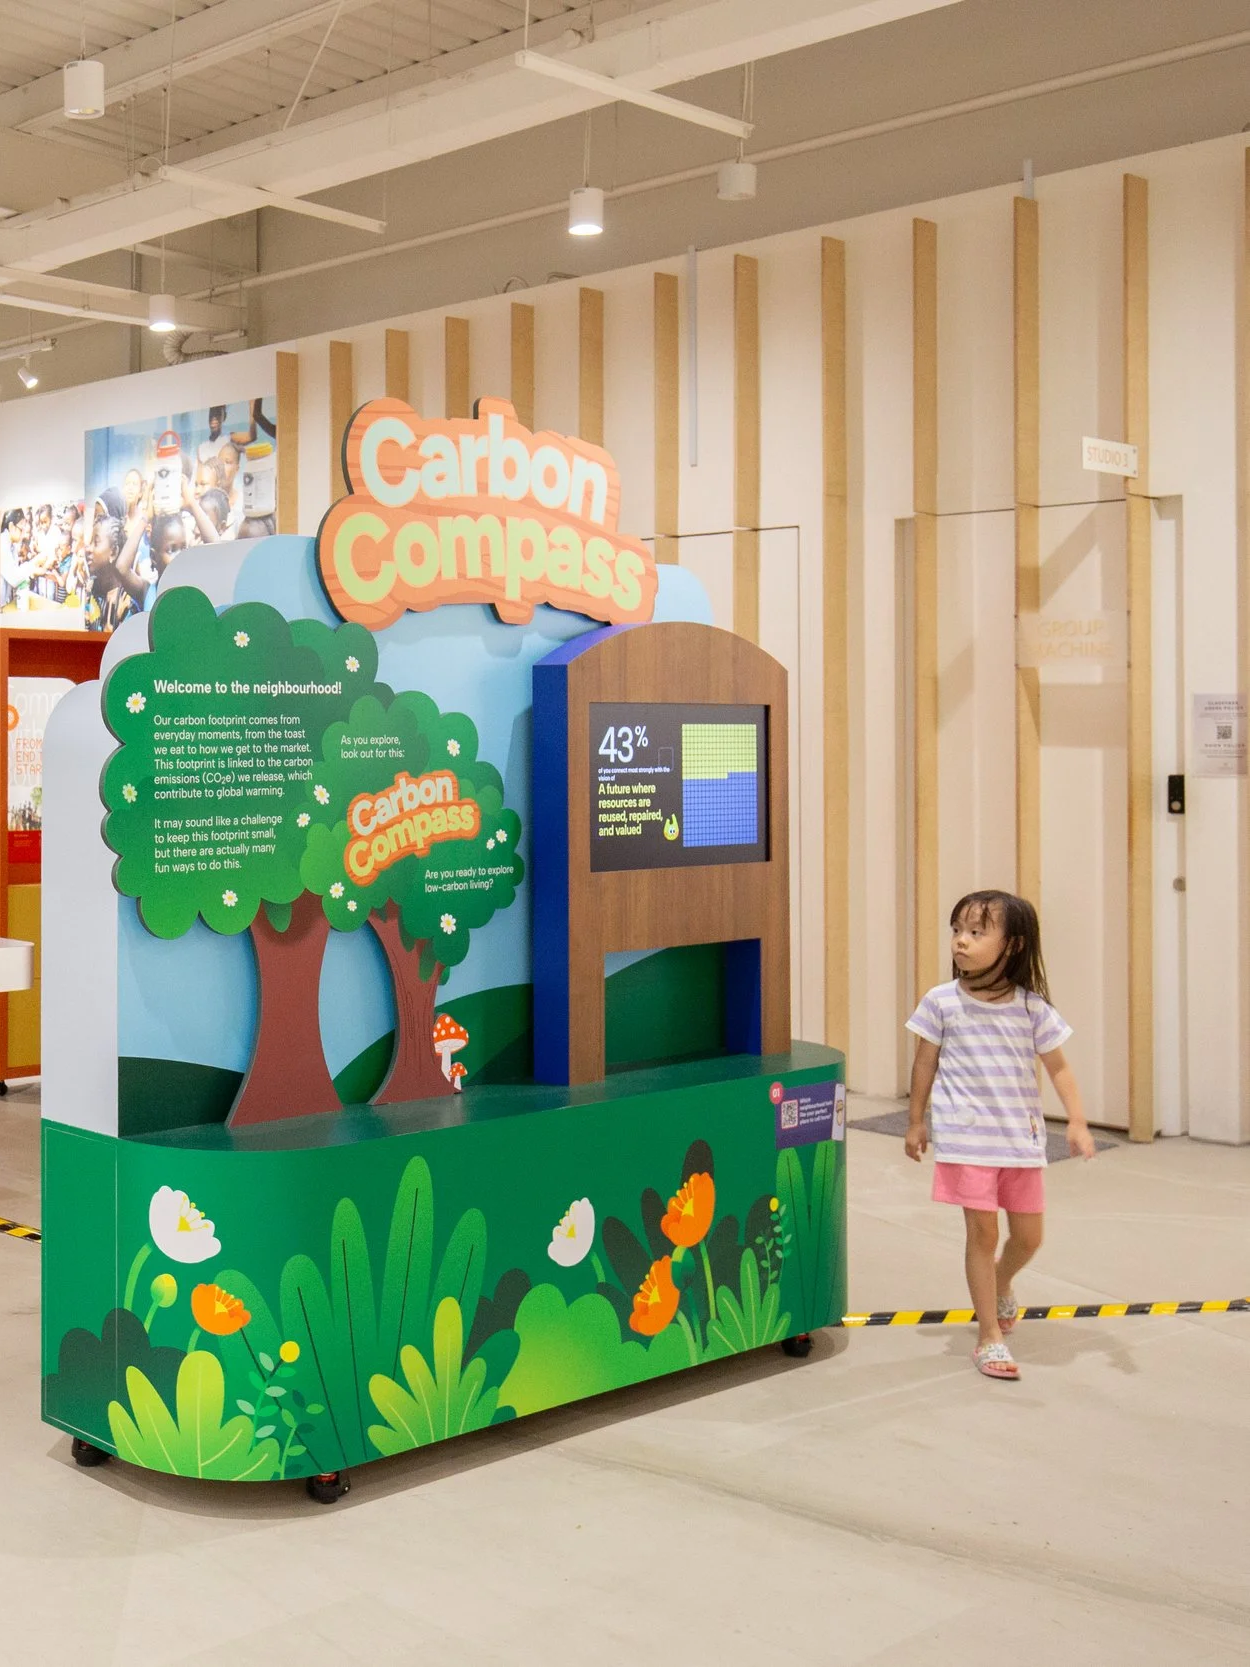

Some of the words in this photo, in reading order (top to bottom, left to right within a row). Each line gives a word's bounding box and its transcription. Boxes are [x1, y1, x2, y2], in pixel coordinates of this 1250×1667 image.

[1086, 446, 1121, 466] STUDIO
[360, 412, 607, 525] Carbon
[334, 512, 646, 611] Compass
[154, 680, 212, 694] Welcome
[215, 682, 227, 694] to
[230, 680, 250, 694] the
[253, 681, 342, 697] neighbourhood!
[154, 715, 171, 725] Our
[174, 716, 205, 725] carbon
[208, 715, 246, 726] footprint
[280, 714, 300, 724] from
[154, 730, 195, 742] everyday
[198, 730, 242, 740] moments,
[245, 729, 265, 739] from
[268, 729, 282, 738] the
[284, 729, 305, 738] toast
[341, 735, 351, 744] As
[353, 737, 368, 746] you
[370, 735, 400, 746] explore,
[170, 746, 184, 754] eat
[188, 745, 196, 754] to
[200, 744, 218, 754] how
[236, 744, 250, 756] get
[253, 744, 262, 753] to
[264, 743, 278, 752] the
[280, 743, 311, 752] market.
[598, 725, 648, 763] 43%
[16, 751, 36, 762] END
[341, 749, 358, 758] look
[360, 749, 374, 758] out
[375, 748, 387, 758] for
[388, 748, 405, 758] this:
[16, 764, 42, 775] STAR
[155, 759, 174, 769] This
[176, 759, 215, 770] footprint
[218, 758, 225, 768] is
[228, 758, 253, 768] linked
[256, 758, 265, 767] to
[268, 757, 281, 767] the
[284, 757, 313, 766] carbon
[154, 774, 200, 784] emissions
[253, 772, 285, 782] release,
[288, 770, 312, 780] which
[154, 788, 202, 799] contribute
[204, 789, 214, 797] to
[216, 786, 243, 799] global
[246, 788, 284, 797] warming.
[598, 784, 605, 795] A
[607, 783, 630, 794] future
[632, 782, 656, 794] where
[352, 776, 453, 836] Carbon
[599, 799, 637, 808] resources
[638, 798, 651, 807] are
[155, 819, 160, 828] It
[164, 820, 182, 830] may
[186, 816, 213, 827] sound
[216, 816, 231, 826] like
[241, 814, 282, 826] challenge
[599, 810, 628, 823] reused,
[629, 809, 663, 823] repaired,
[155, 835, 164, 843] to
[167, 833, 189, 844] keep
[192, 832, 208, 841] this
[211, 830, 249, 842] footprint
[252, 828, 276, 839] small,
[599, 825, 615, 836] and
[616, 823, 642, 835] valued
[349, 804, 474, 877] Compass
[155, 848, 170, 858] but
[173, 847, 196, 857] there
[200, 848, 214, 856] are
[216, 844, 250, 855] actually
[252, 845, 275, 854] many
[155, 863, 169, 873] fun
[172, 864, 194, 873] ways
[198, 862, 207, 870] to
[209, 860, 221, 870] do
[224, 859, 241, 868] this.
[426, 870, 438, 878] Are
[440, 871, 454, 879] you
[456, 868, 476, 877] ready
[487, 865, 514, 876] explore
[426, 882, 468, 892] low-carbon
[470, 879, 493, 890] living?
[772, 1088, 780, 1098] 01
